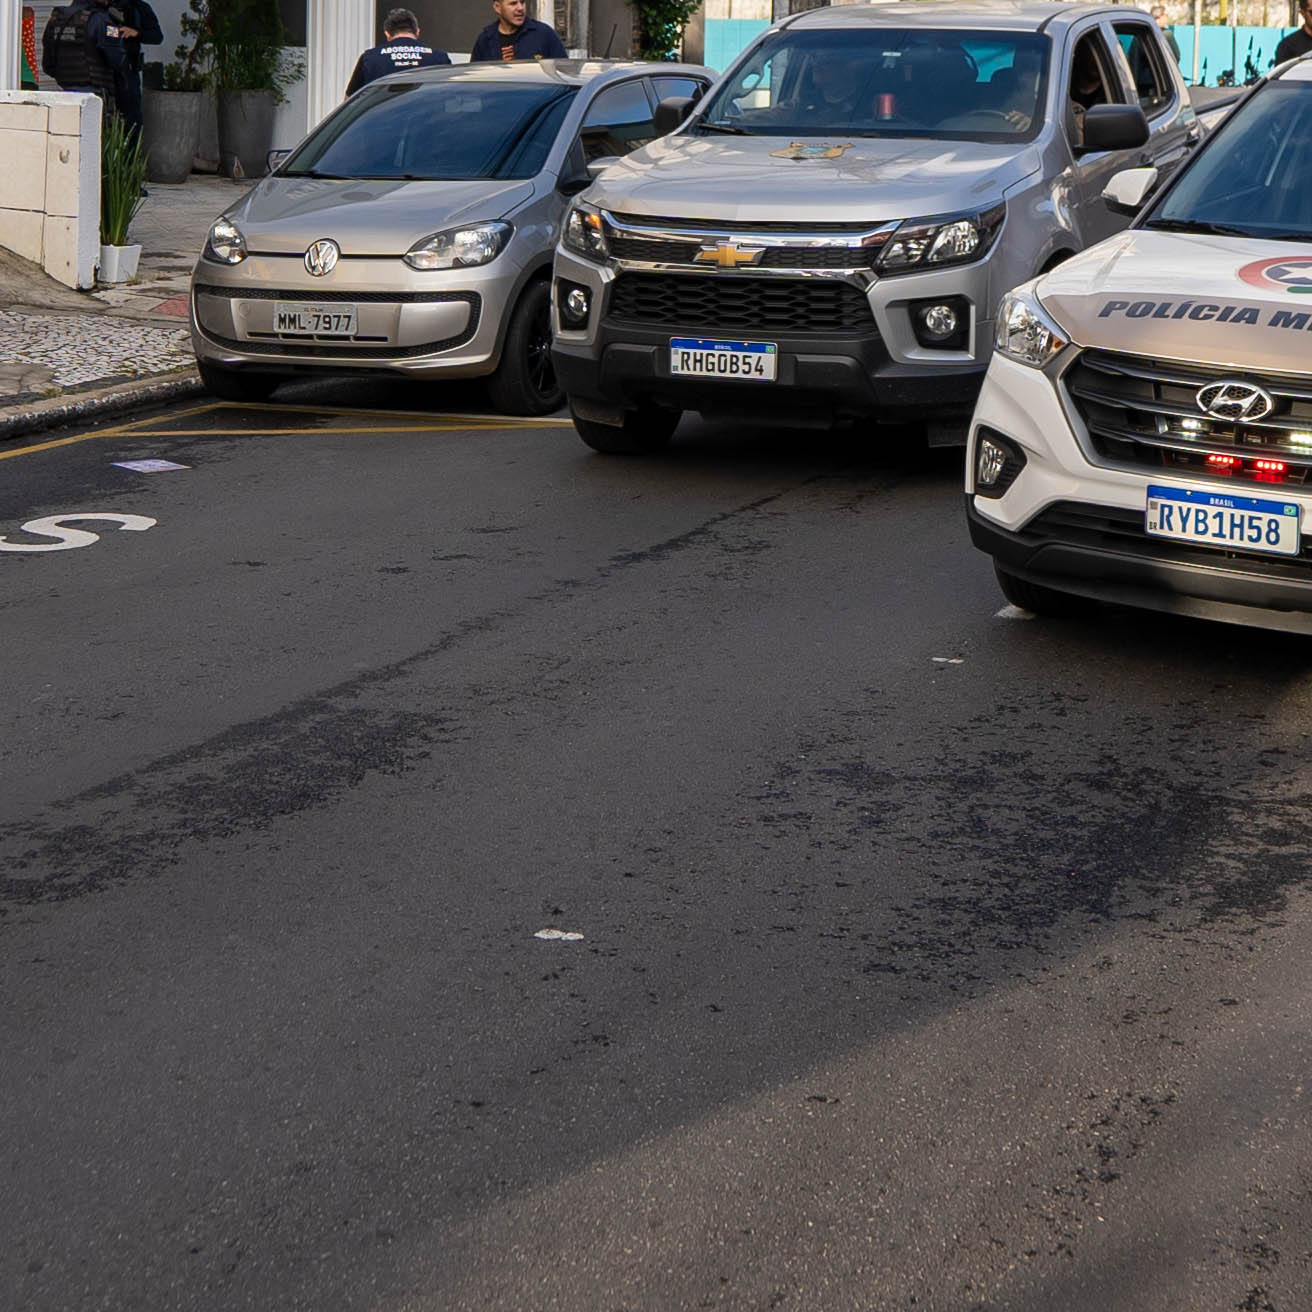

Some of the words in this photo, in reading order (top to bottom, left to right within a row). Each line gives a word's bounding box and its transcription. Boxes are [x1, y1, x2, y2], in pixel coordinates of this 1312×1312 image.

[391, 52, 423, 61] SOCIAL
[1098, 299, 1261, 326] POLÍCIA
[1209, 496, 1235, 508] BRASIL
[1159, 503, 1281, 546] RYB1H58
